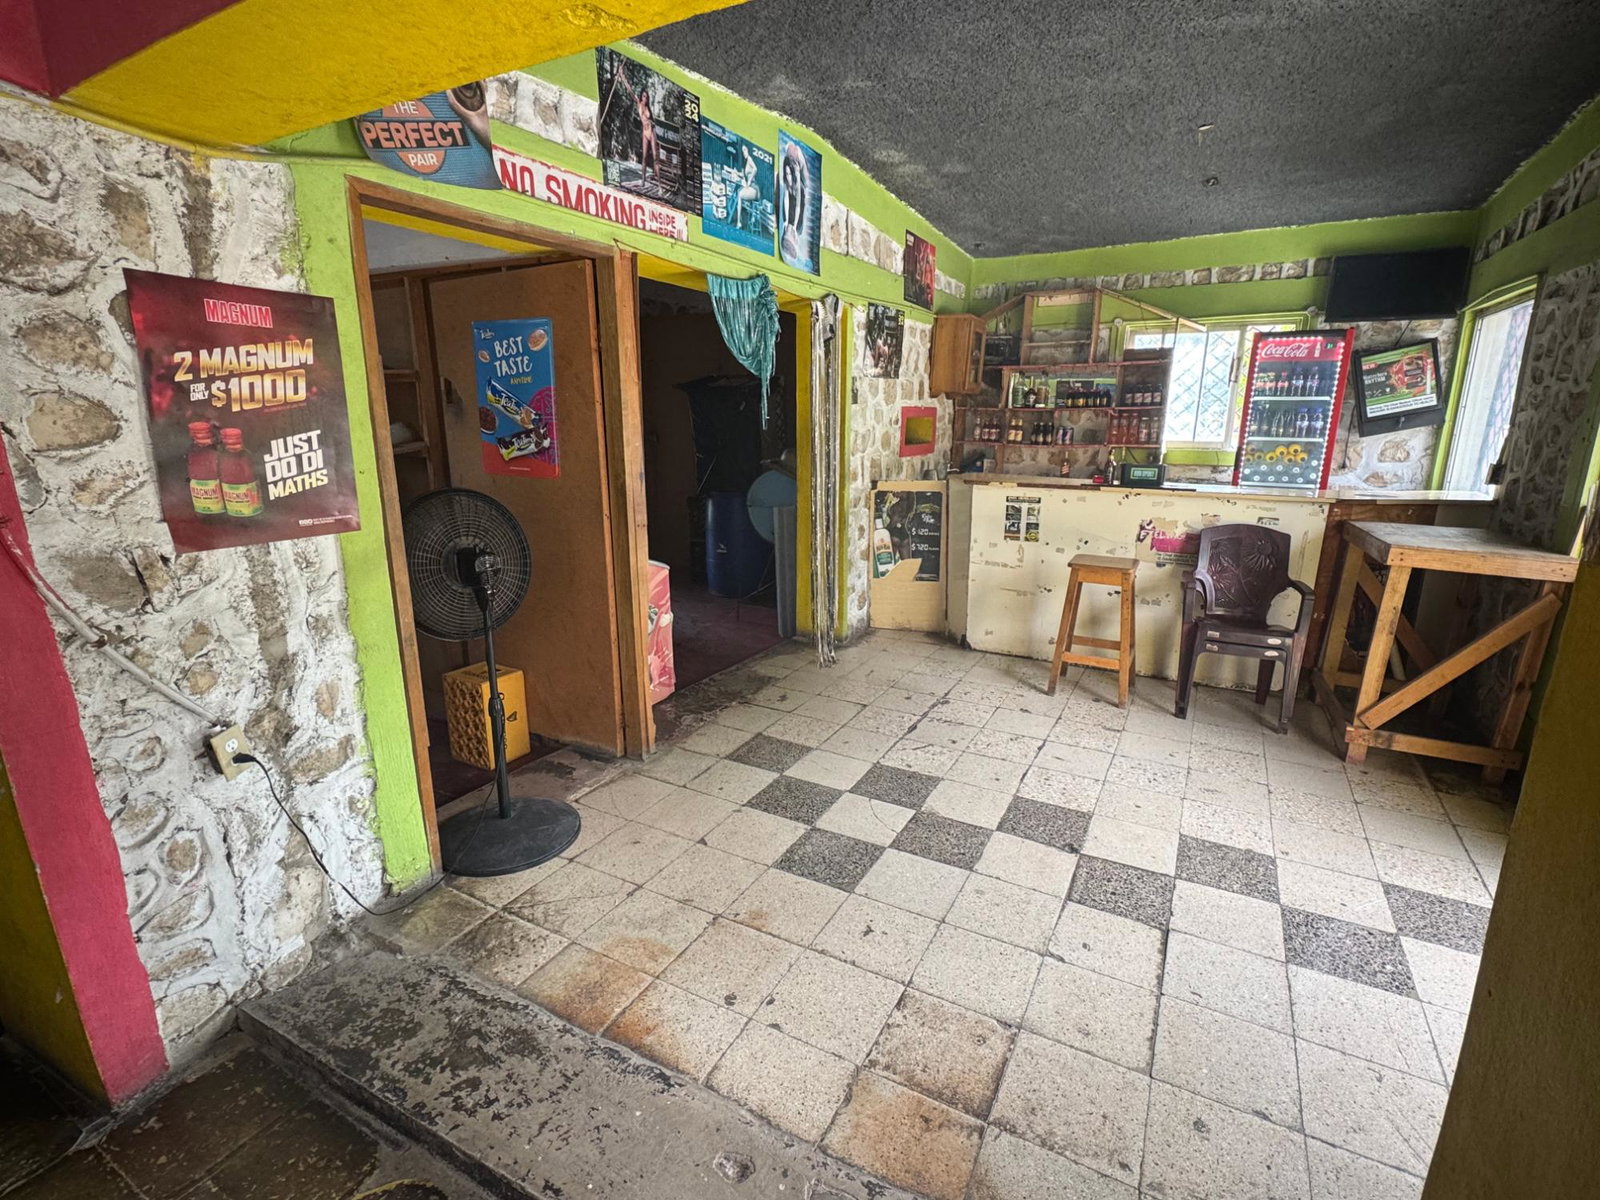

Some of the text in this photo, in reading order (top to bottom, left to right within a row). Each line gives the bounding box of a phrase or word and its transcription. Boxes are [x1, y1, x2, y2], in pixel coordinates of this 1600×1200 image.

[393, 100, 419, 115] THE
[360, 121, 465, 148] PERFECT
[408, 153, 438, 166] PAIR
[752, 147, 773, 164] 2021
[499, 158, 647, 231] NO SMOKING
[649, 209, 677, 229] INSIDE
[203, 298, 273, 329] MAGNUM
[493, 336, 523, 358] BEST
[173, 338, 314, 382] 2 MAGNUM
[494, 356, 533, 377] TASTE
[190, 383, 206, 393] FOR
[190, 390, 210, 401] ONLY
[210, 369, 307, 413] $1000
[263, 429, 321, 463] JUST
[265, 449, 324, 483] DO DI
[267, 469, 329, 501] MATHS
